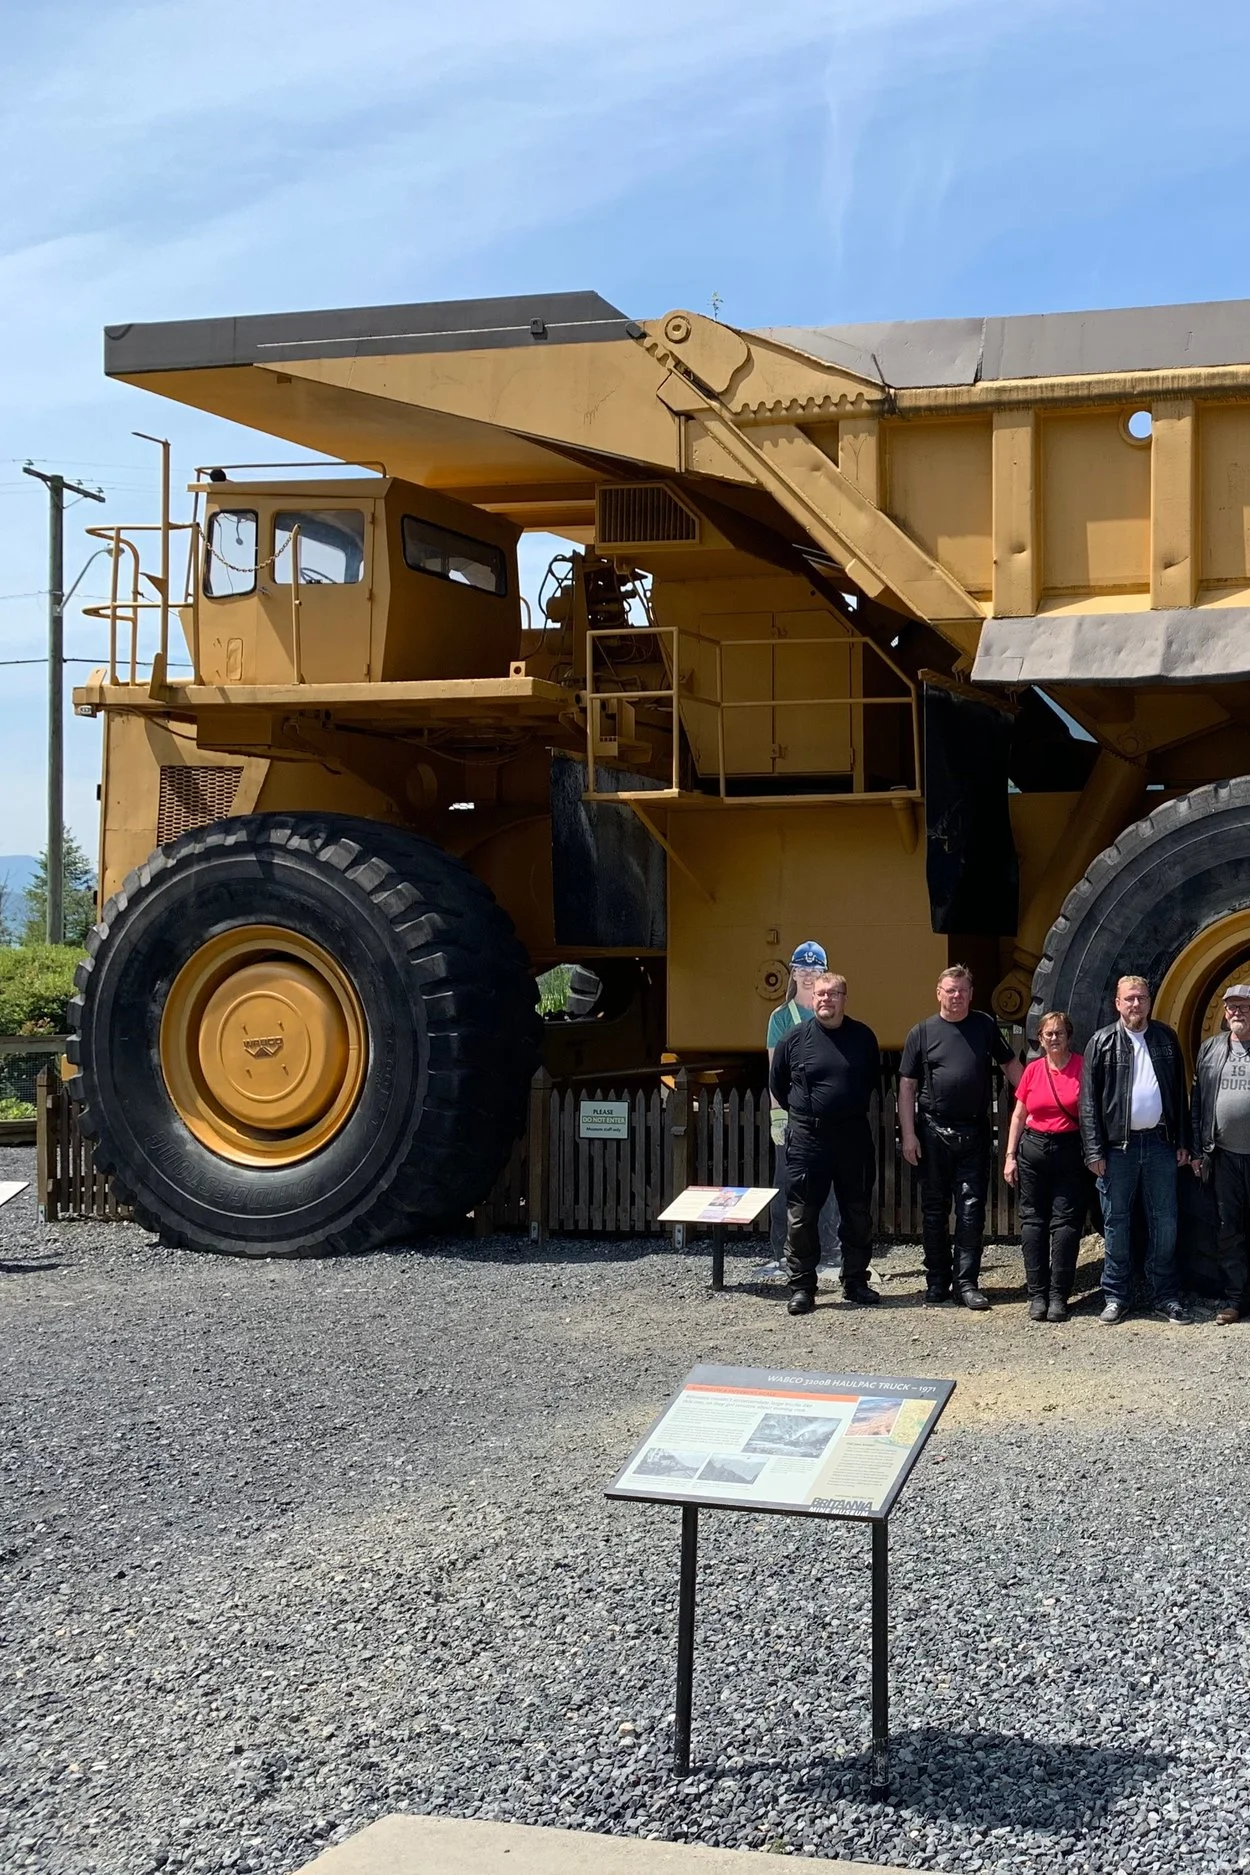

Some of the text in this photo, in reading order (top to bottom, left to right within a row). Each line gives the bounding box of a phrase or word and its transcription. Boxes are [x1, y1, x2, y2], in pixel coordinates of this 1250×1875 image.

[243, 1036, 283, 1048] WABCO
[1231, 1065, 1246, 1077] IS
[768, 1374, 803, 1385] WABCO
[803, 1378, 831, 1388] 3200B
[831, 1379, 876, 1389] HAULPAC
[878, 1382, 911, 1391] TRUCK
[811, 1497, 873, 1511] BRITANNIA
[809, 1506, 869, 1517] MINE MUSEUM
